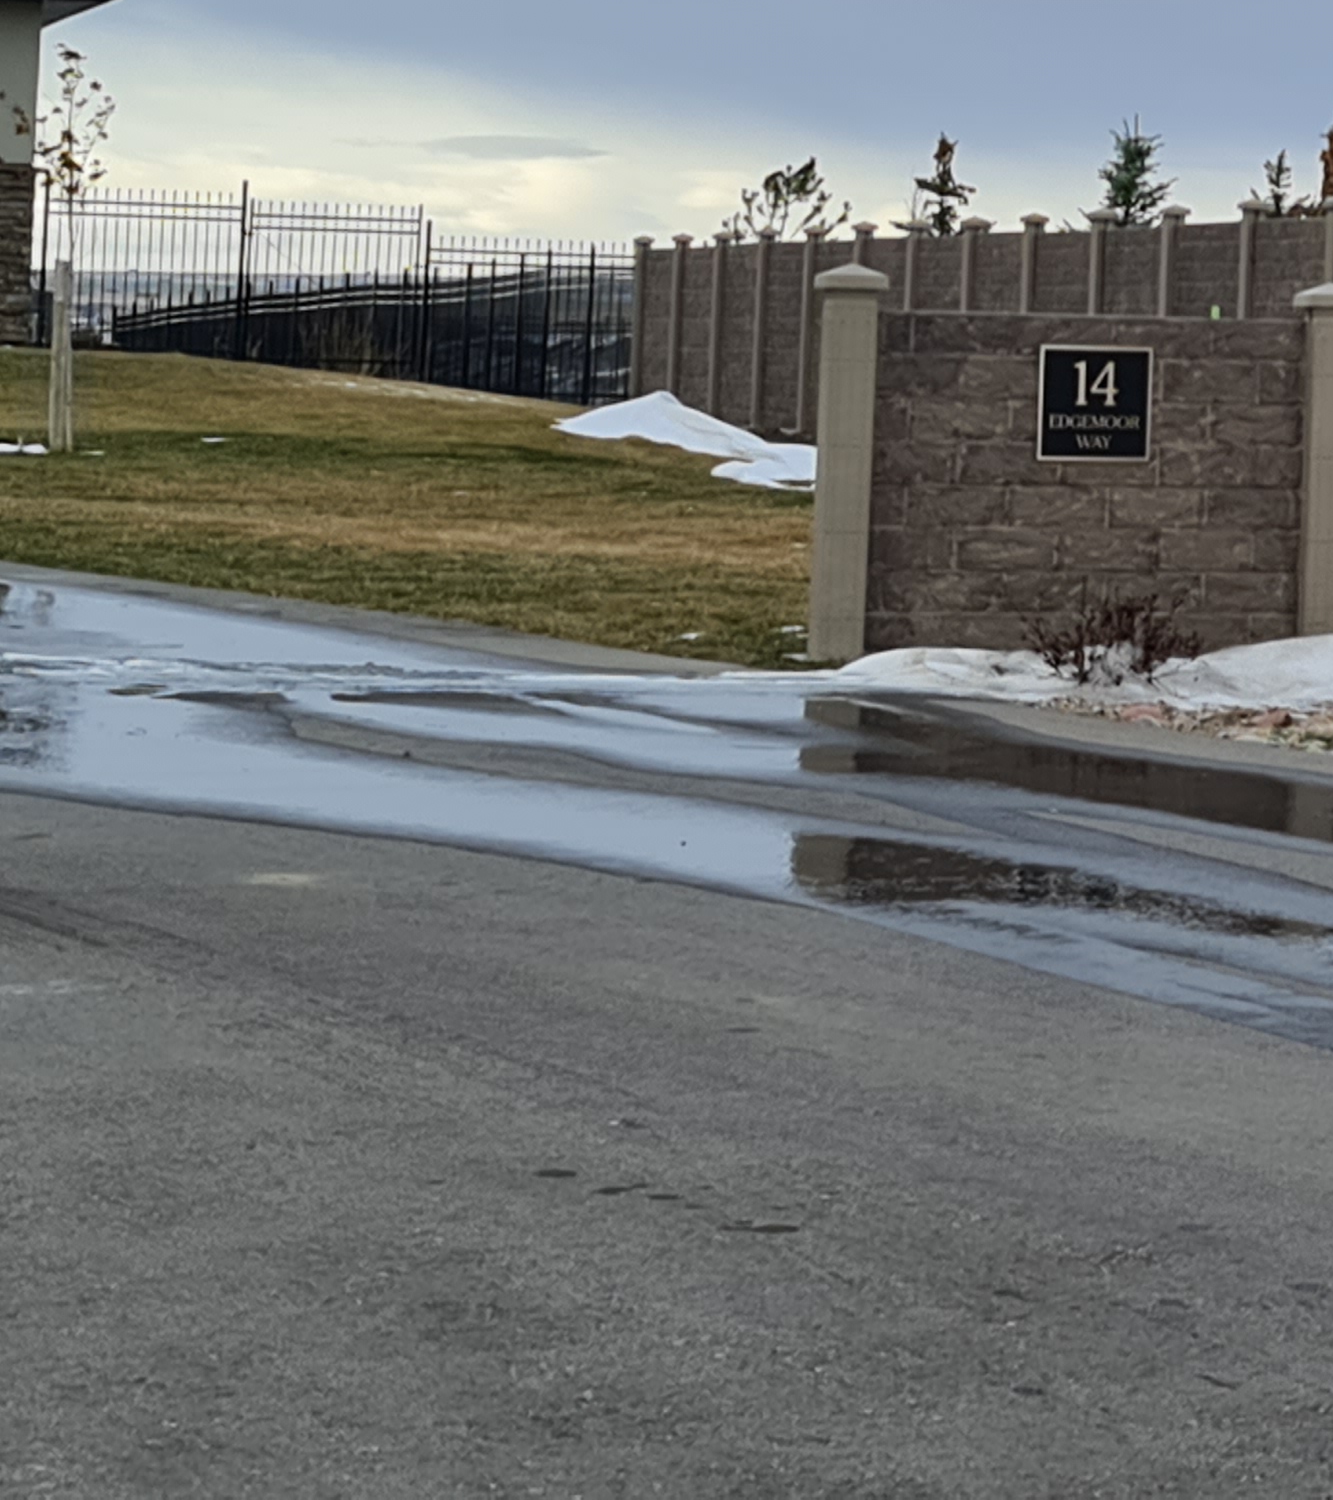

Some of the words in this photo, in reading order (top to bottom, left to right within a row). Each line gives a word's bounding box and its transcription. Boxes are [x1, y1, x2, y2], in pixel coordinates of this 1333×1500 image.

[1074, 360, 1119, 406] 14
[1049, 414, 1140, 429] EDGEMOOR
[1076, 434, 1112, 449] WAY
